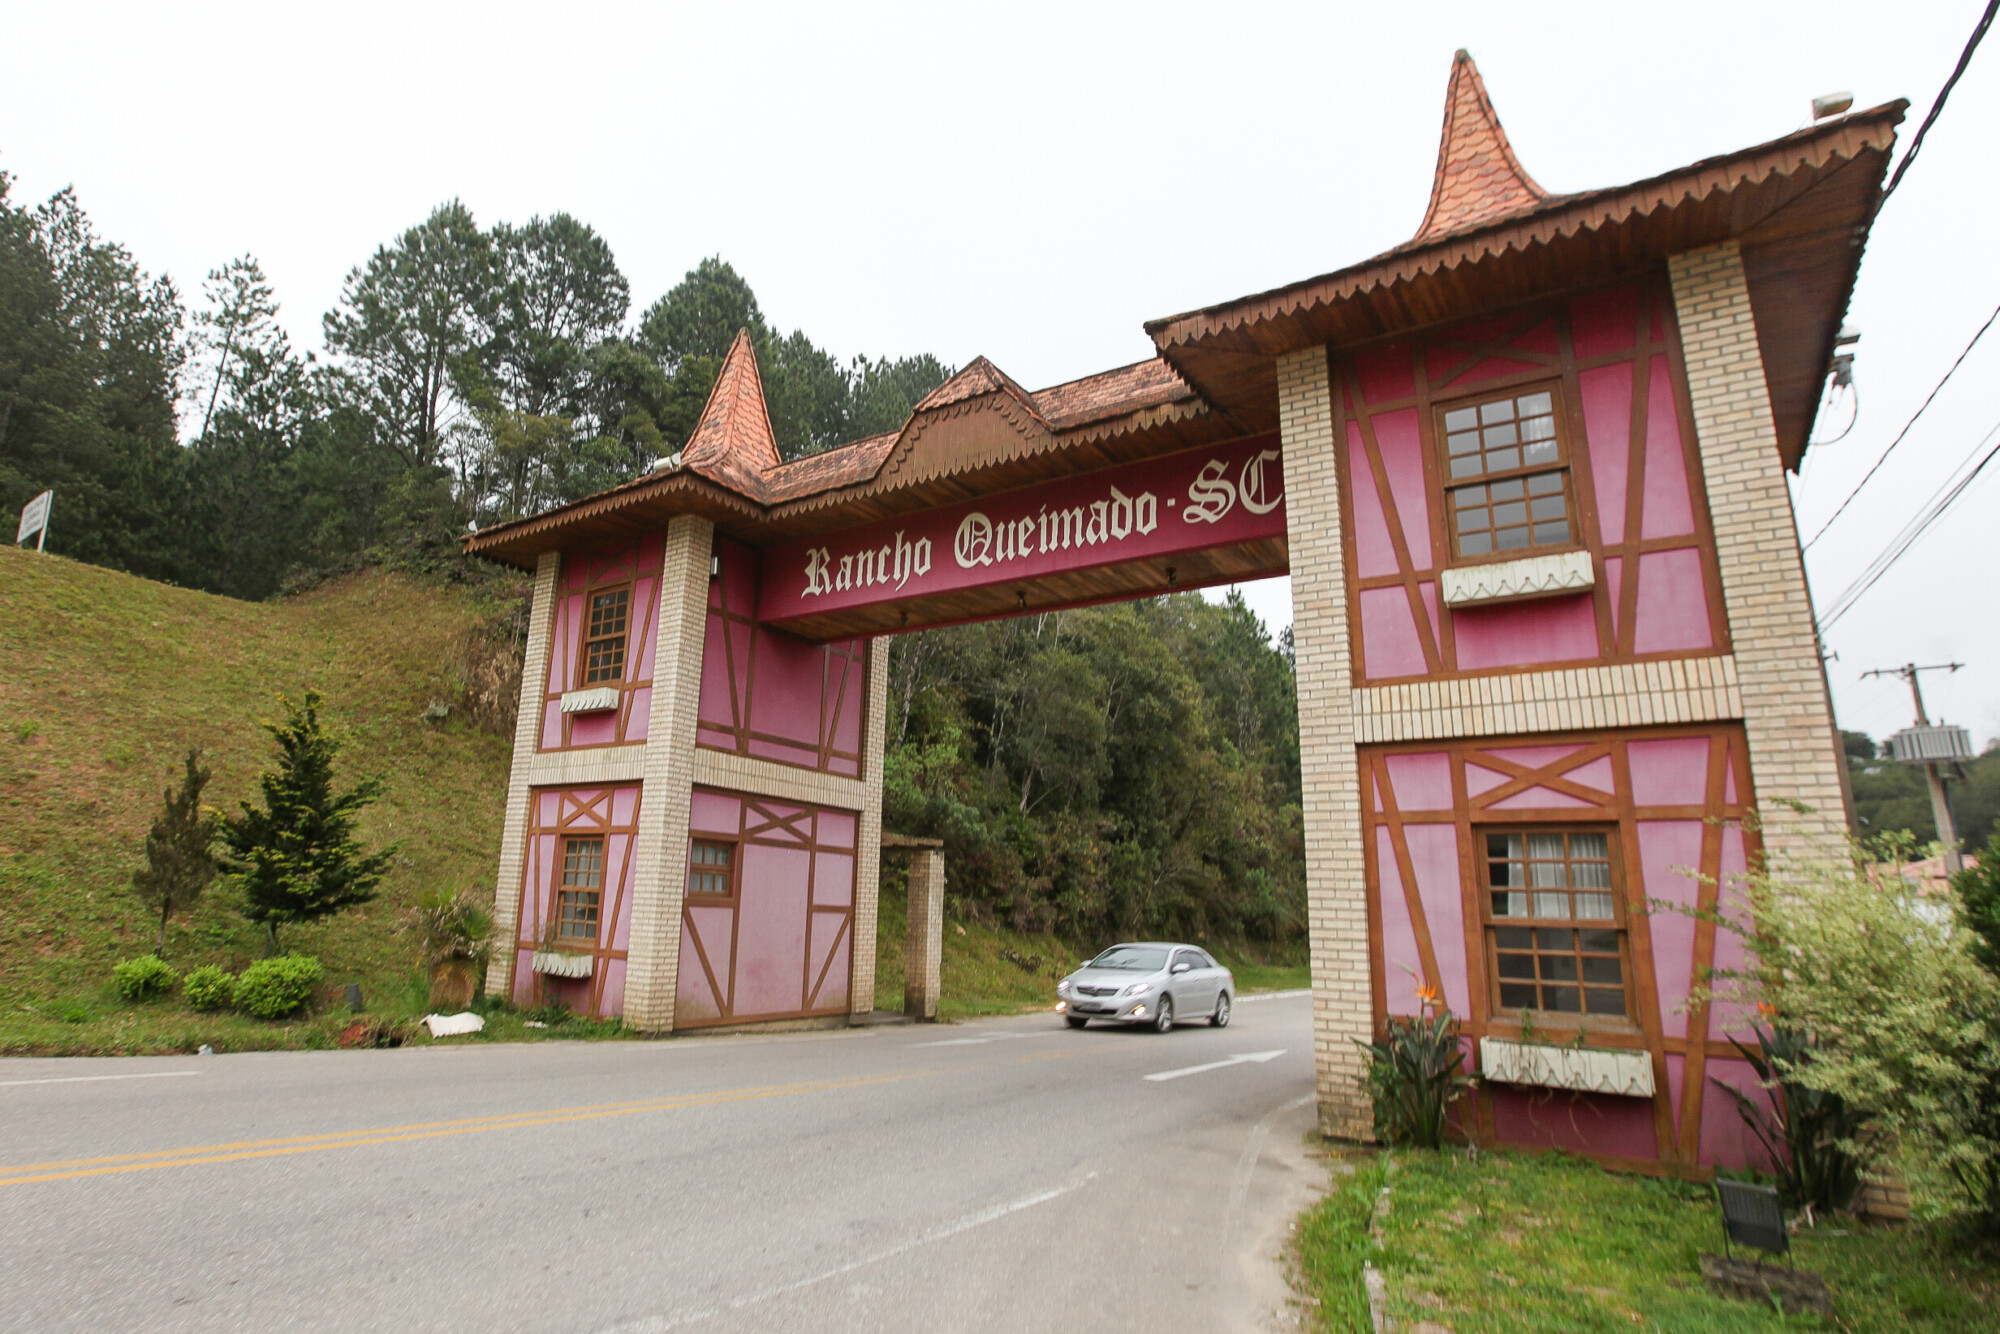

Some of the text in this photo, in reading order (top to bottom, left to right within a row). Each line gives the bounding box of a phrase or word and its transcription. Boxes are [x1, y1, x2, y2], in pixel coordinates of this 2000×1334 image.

[801, 530, 932, 599] Rancho
[954, 485, 1159, 569] Queimado
[1182, 449, 1284, 524] SC
